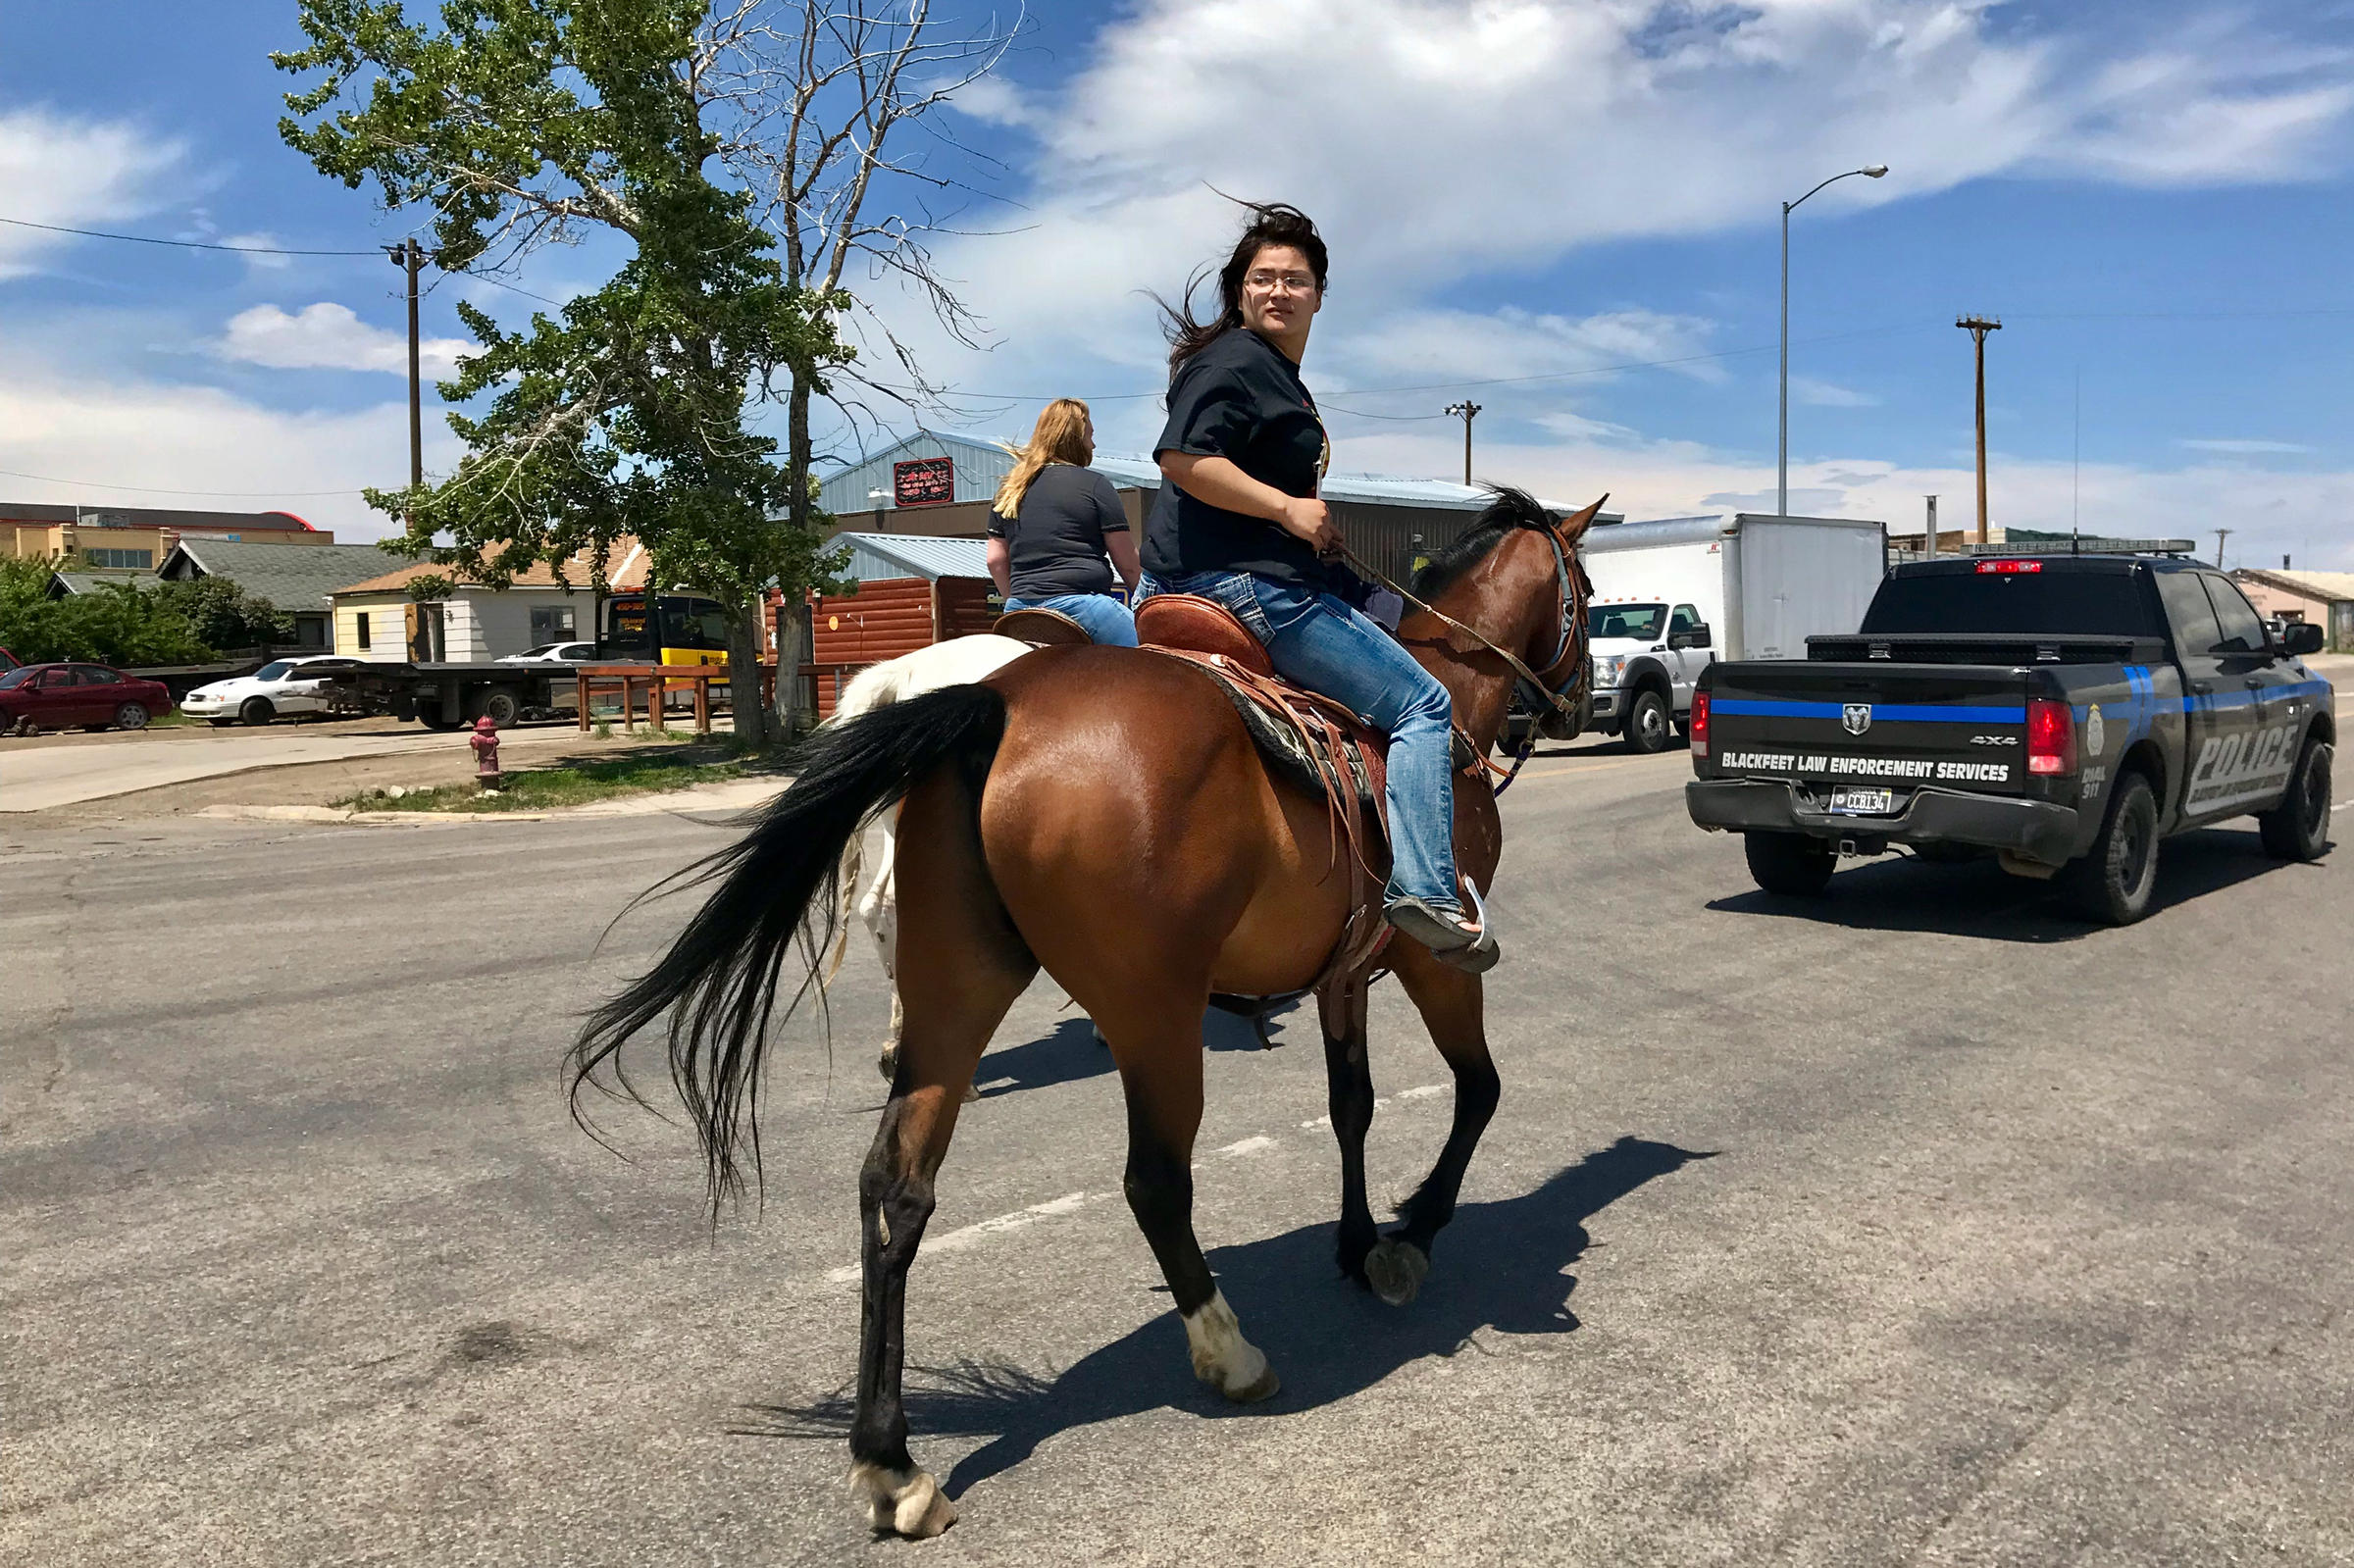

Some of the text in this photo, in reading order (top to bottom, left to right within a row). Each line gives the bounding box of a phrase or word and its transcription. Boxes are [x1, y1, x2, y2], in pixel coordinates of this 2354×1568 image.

[2191, 725, 2298, 782] POLICE
[1721, 752, 2009, 782] BLACKFEET LAW ENFORCEMENT SERVICES
[2081, 766, 2105, 784] DIAL
[2081, 783, 2099, 799] 911
[1847, 794, 1884, 810] CCB134
